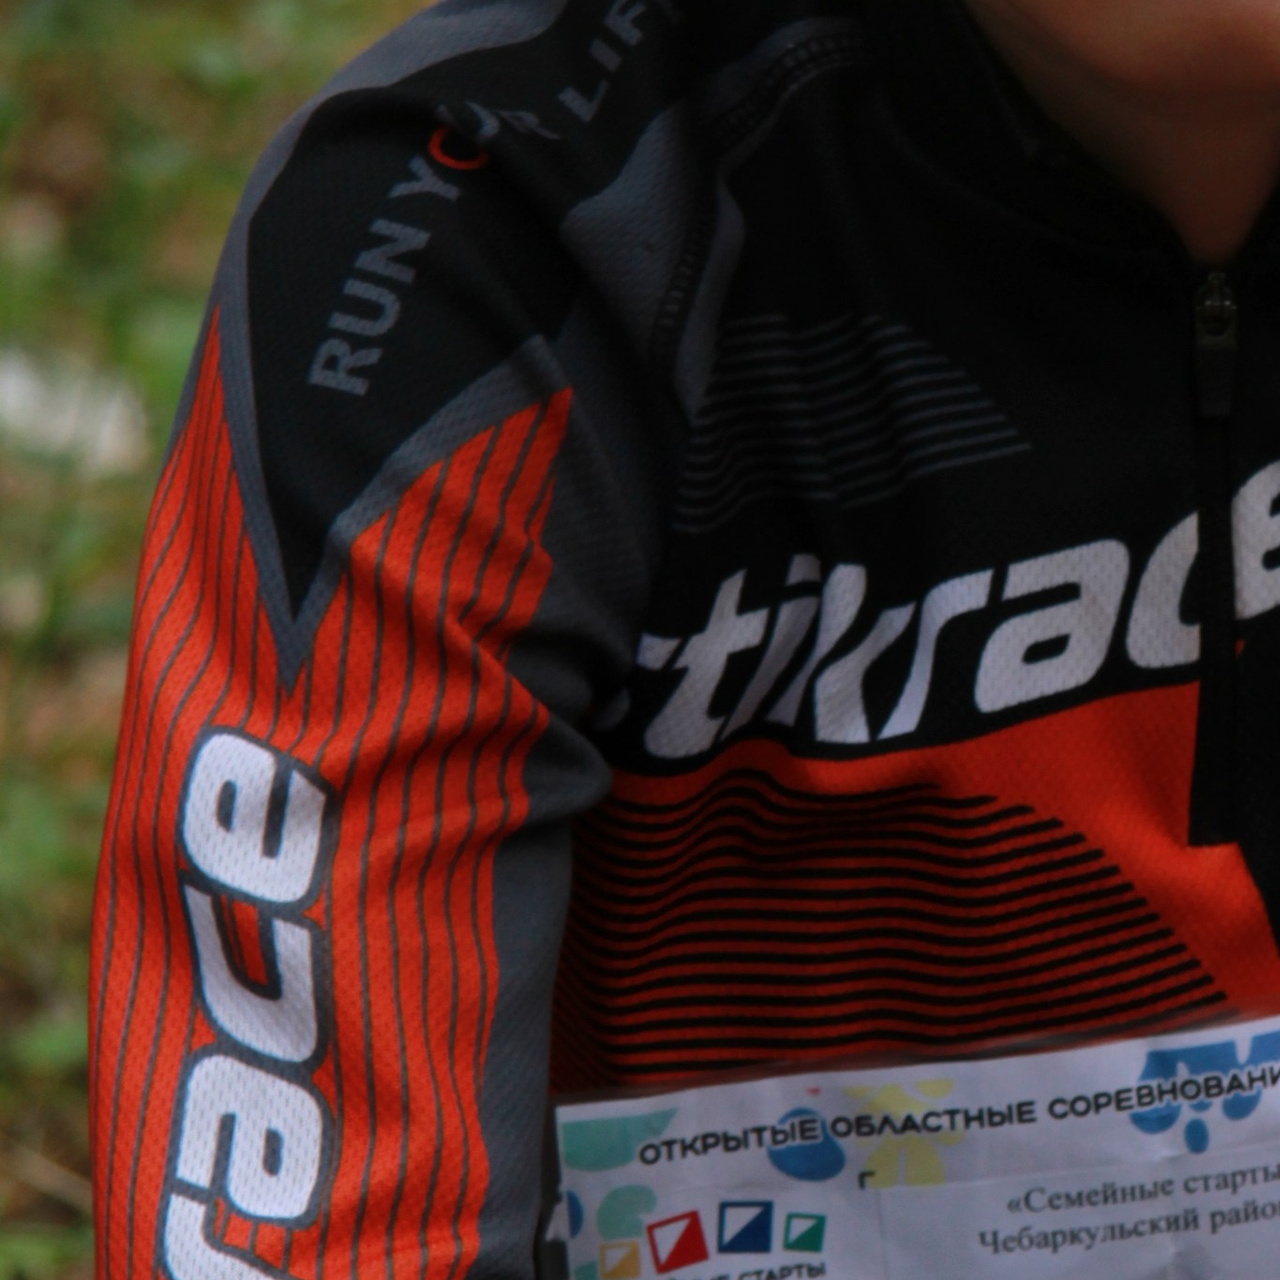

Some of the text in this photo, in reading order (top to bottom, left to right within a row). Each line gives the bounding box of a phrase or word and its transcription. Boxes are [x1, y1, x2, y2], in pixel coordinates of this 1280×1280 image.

[308, 218, 431, 396] RUN
[639, 1119, 820, 1165] ОТКРЫТЫЕ
[830, 1102, 1037, 1140] ОБЛАСТНЫЕ
[1006, 1177, 1174, 1214] «Семейные
[978, 1206, 1202, 1256] Чебаркульский
